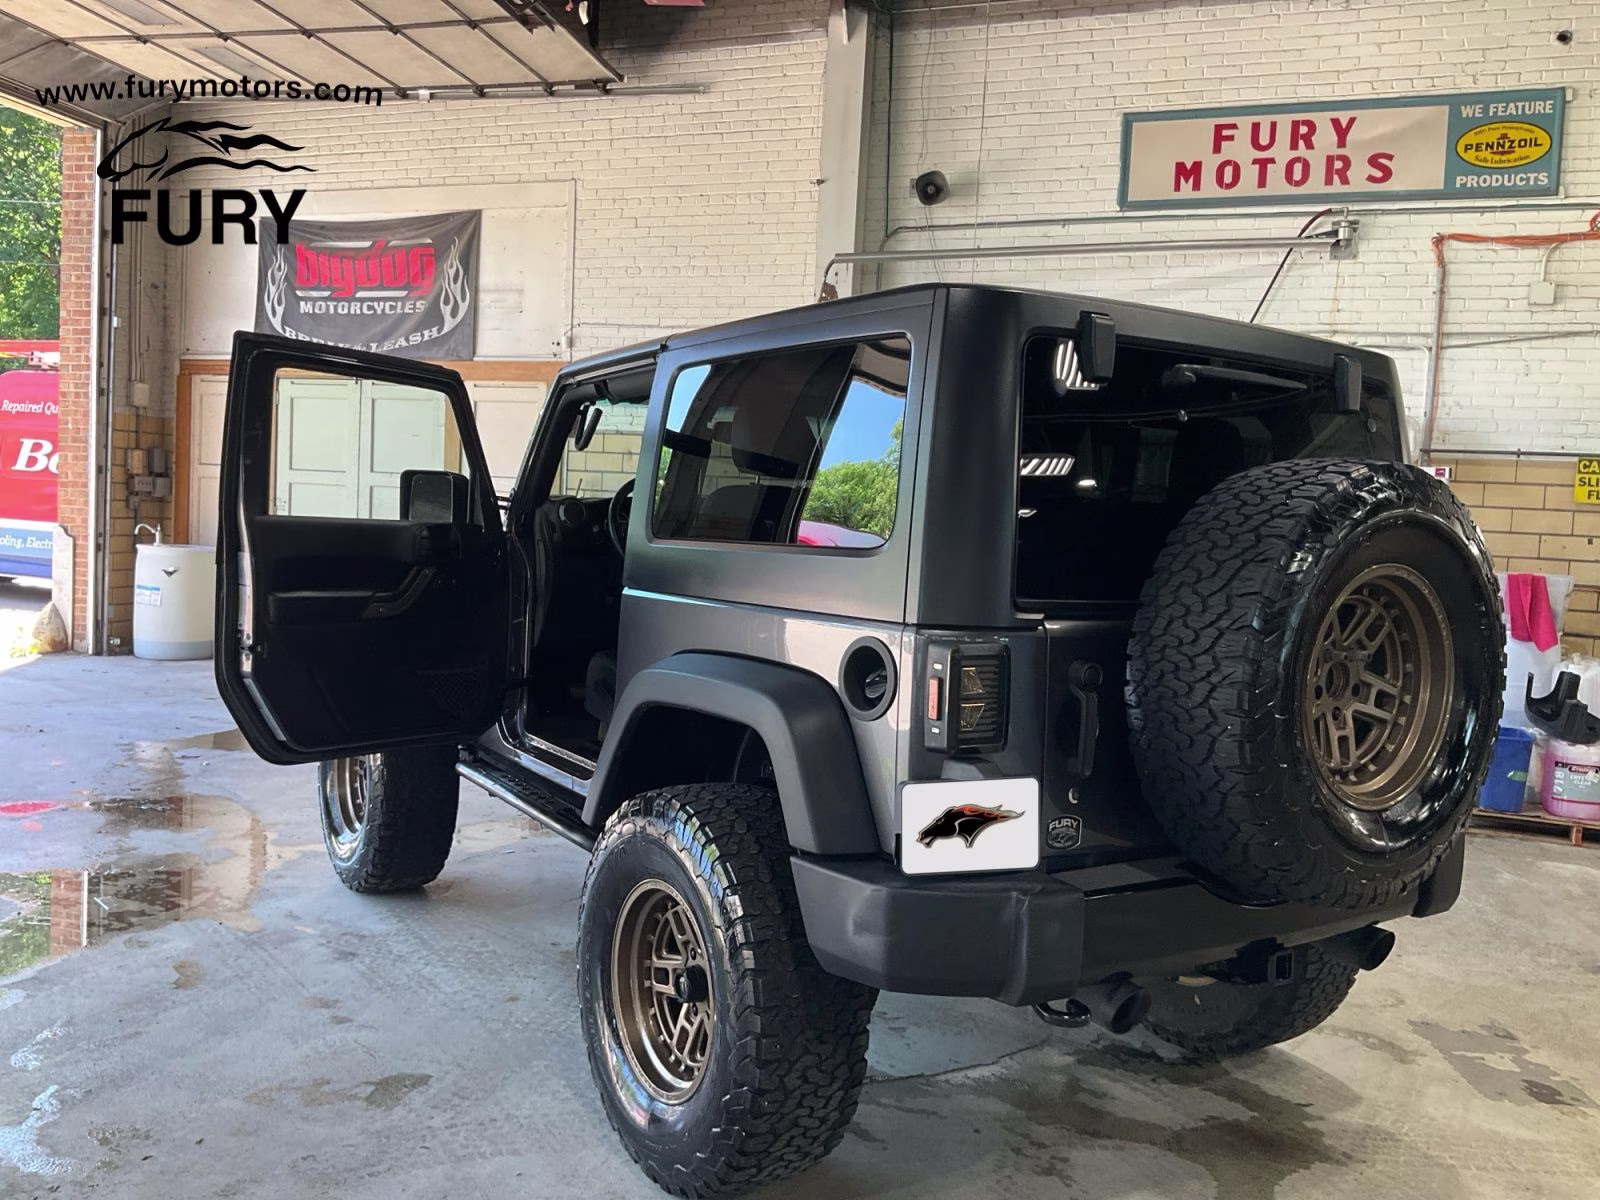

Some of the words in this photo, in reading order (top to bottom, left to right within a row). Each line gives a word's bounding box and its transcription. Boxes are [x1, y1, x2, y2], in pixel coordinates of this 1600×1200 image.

[1461, 105, 1484, 118] WE
[1489, 100, 1554, 117] FEATURE
[1212, 116, 1358, 155] FURY
[1463, 138, 1543, 153] PENNZOIL
[1173, 152, 1395, 193] MOTORS
[1455, 172, 1549, 188] PRODUCTS
[299, 300, 427, 315] MOTORCYCLES
[369, 326, 444, 352] LEASH
[1, 399, 44, 415] Repaired
[1579, 460, 1600, 473] CA
[1578, 476, 1600, 488] SLI
[1049, 818, 1078, 832] FURY
